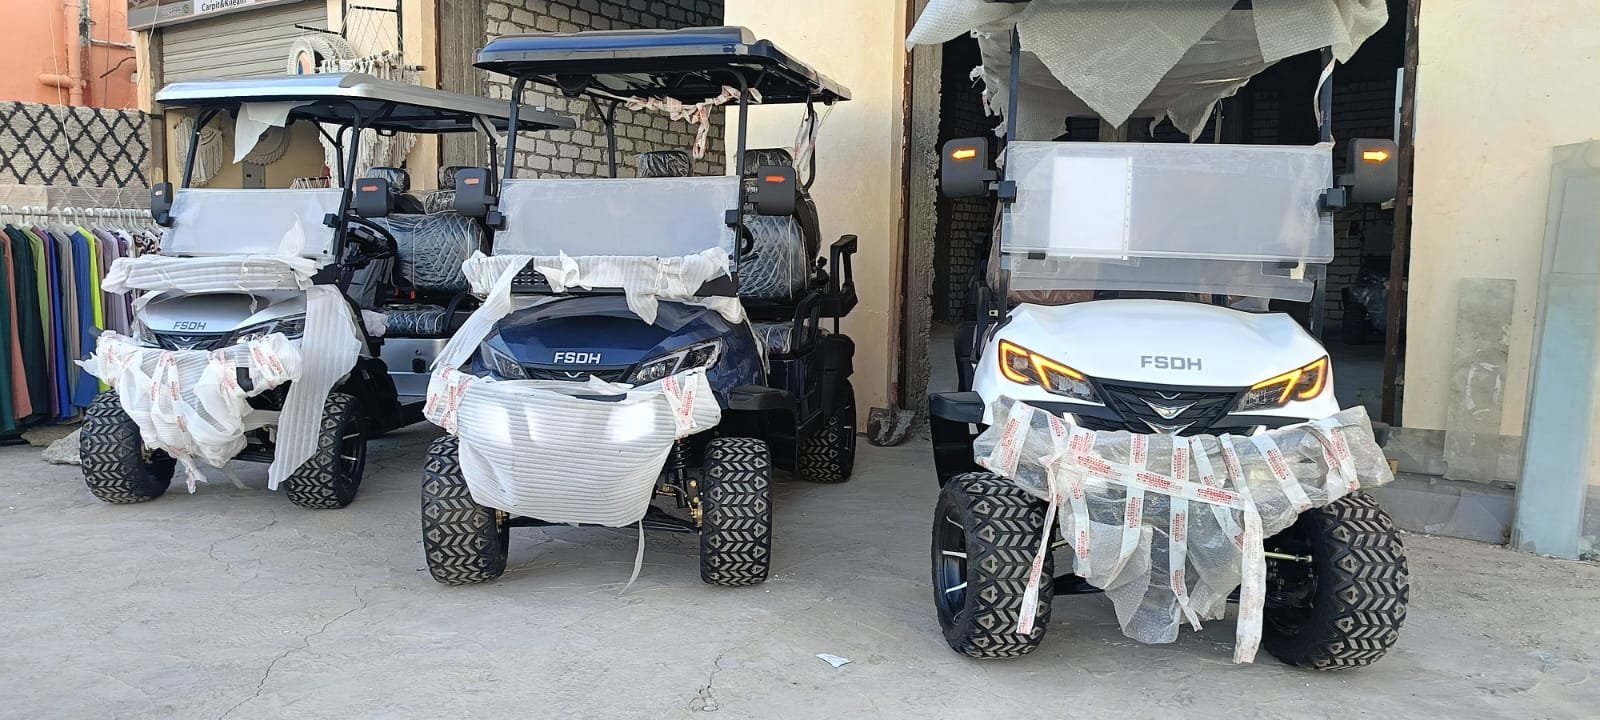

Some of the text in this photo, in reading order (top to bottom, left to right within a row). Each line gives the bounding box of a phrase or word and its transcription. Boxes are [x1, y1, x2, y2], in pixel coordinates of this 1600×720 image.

[173, 321, 207, 330] FSDH
[553, 351, 601, 365] FSDH
[1140, 355, 1202, 371] FSDH
